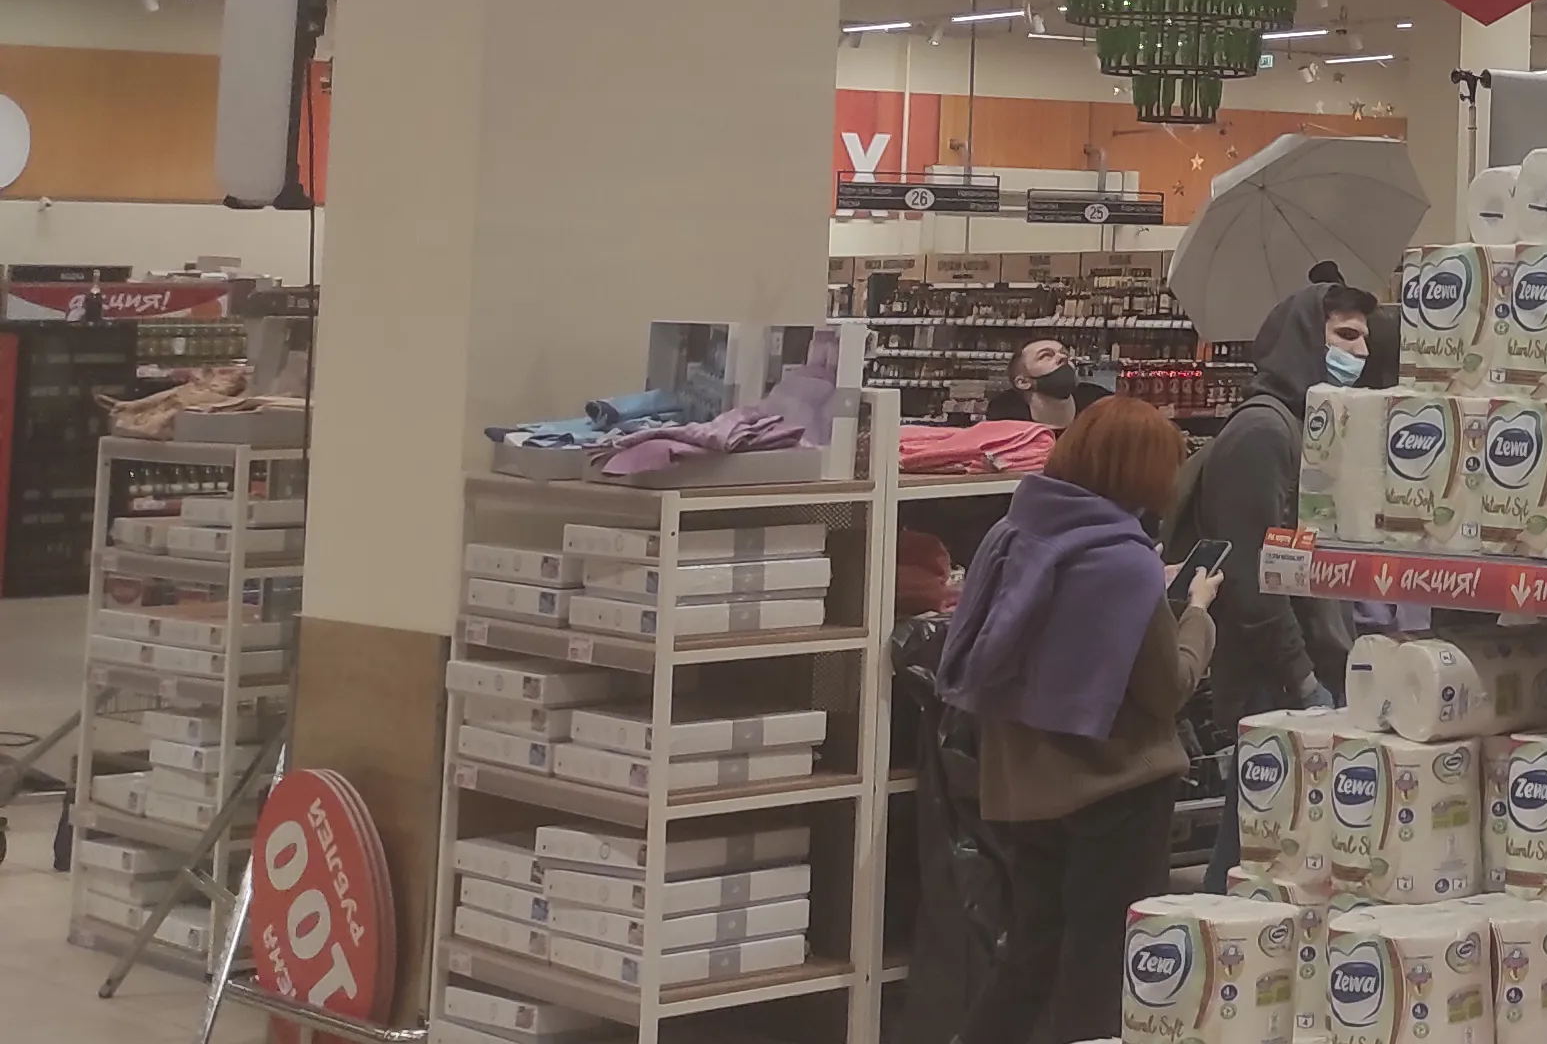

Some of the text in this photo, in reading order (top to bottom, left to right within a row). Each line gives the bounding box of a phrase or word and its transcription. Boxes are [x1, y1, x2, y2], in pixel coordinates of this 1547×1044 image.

[911, 191, 928, 206] 26
[1089, 205, 1105, 220] 25
[68, 291, 171, 311] ация!
[1426, 280, 1457, 300] Zewa
[1444, 337, 1464, 361] Soft
[1395, 430, 1437, 451] Zewa
[1494, 437, 1529, 457] Zewa
[1512, 497, 1529, 521] Sft
[1311, 559, 1356, 587] ция!
[1400, 567, 1482, 598] акция!
[1244, 761, 1278, 782] Zewa
[1338, 774, 1375, 796] Zewa
[265, 820, 358, 1006] 100
[1137, 954, 1176, 976] Zewa
[1335, 970, 1377, 994] Zewa
